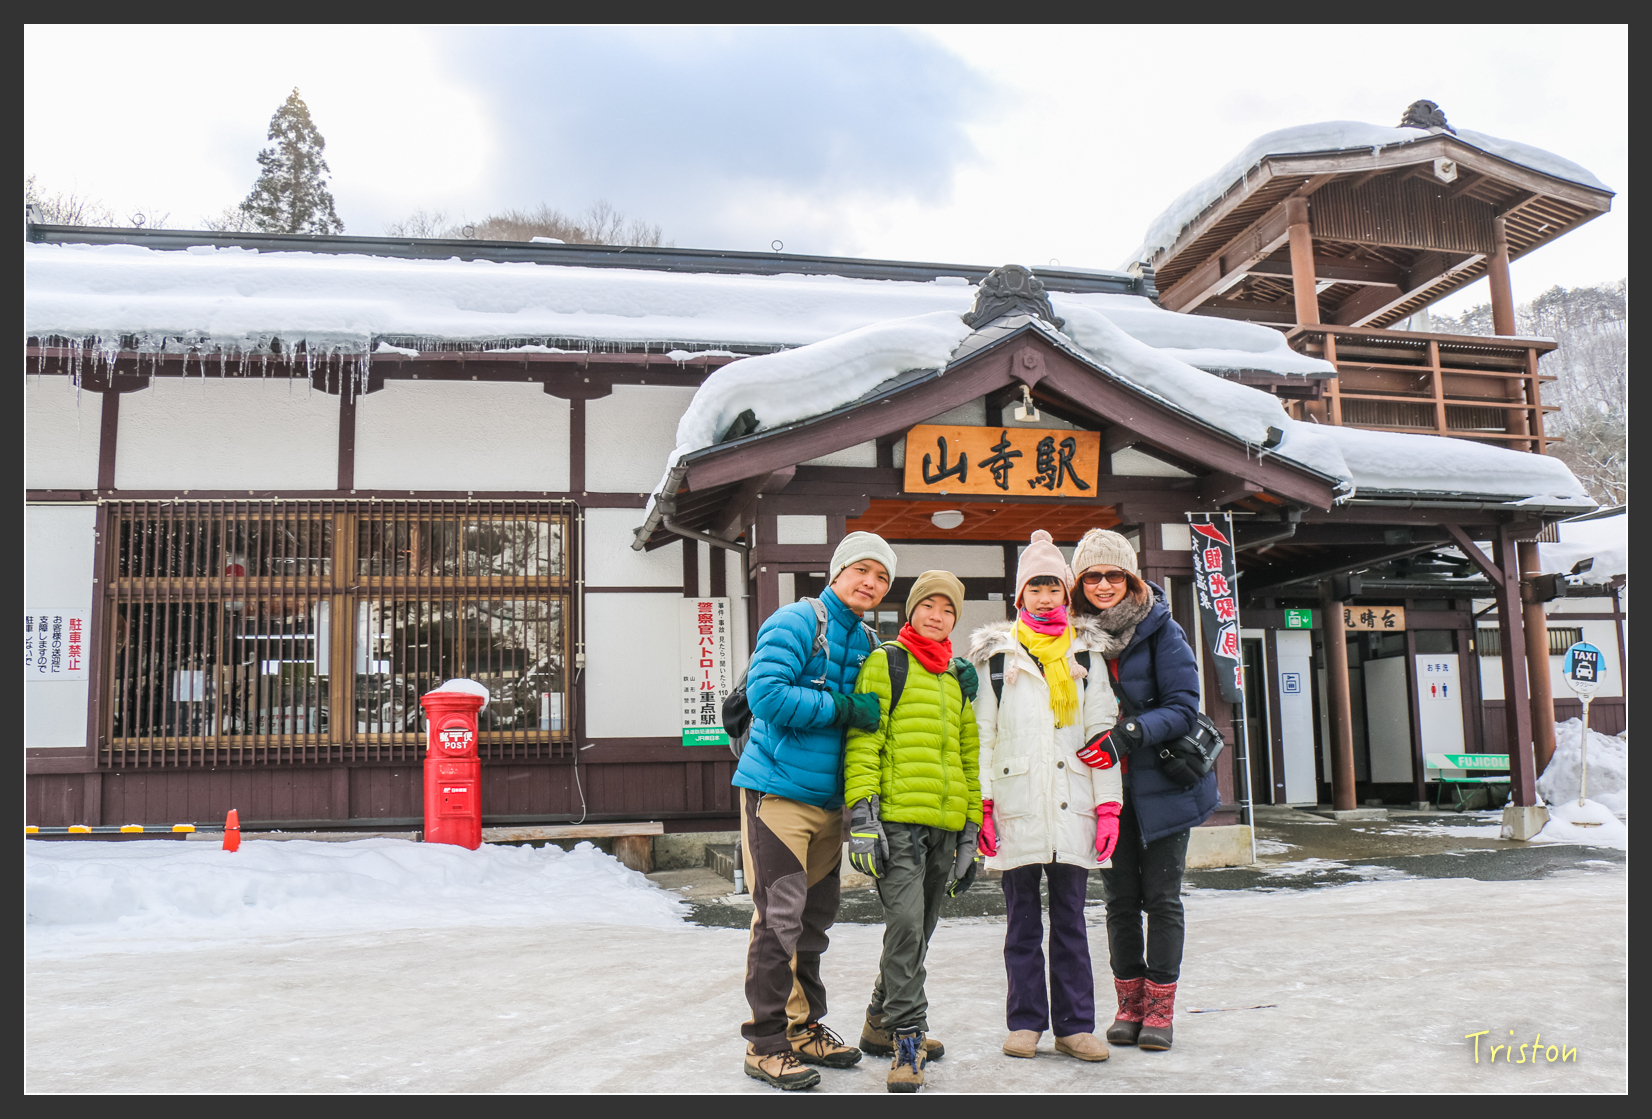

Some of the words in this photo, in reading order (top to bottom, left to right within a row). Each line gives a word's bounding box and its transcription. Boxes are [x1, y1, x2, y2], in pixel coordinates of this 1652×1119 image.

[922, 430, 1091, 491] 山寺駅
[37, 615, 49, 673] 支障しますので
[51, 615, 62, 673] お客様の送迎に
[68, 618, 82, 671] 駐車禁止
[698, 602, 716, 725] 警察官パトロール重点駅
[1573, 650, 1597, 661] TAXI
[444, 741, 468, 749] POST
